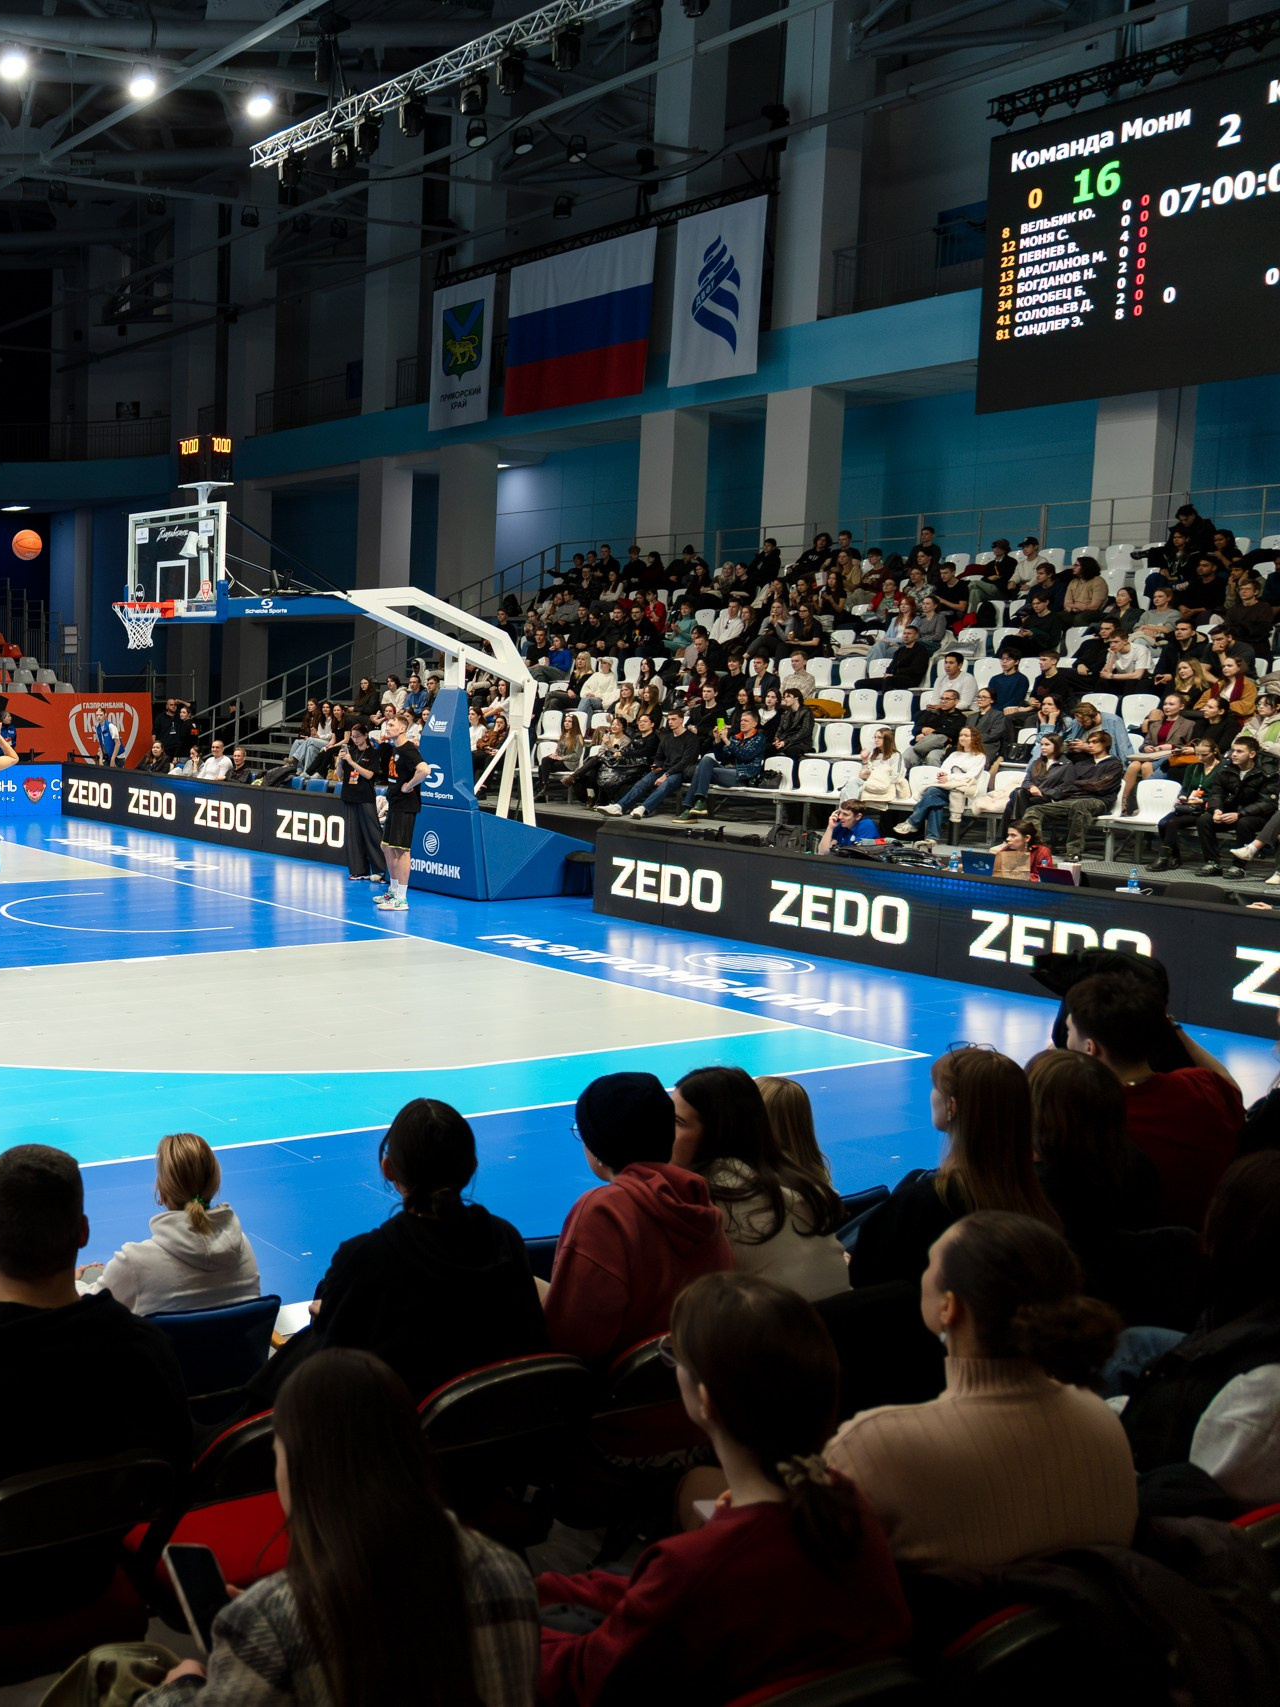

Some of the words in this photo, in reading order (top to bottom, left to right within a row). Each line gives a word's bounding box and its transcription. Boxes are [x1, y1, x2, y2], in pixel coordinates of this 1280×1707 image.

[1010, 130, 1114, 172] Команда
[1121, 109, 1191, 143] Мони
[1216, 113, 1242, 147] 2
[1028, 188, 1043, 209] 0
[1072, 160, 1121, 204] 16
[1002, 227, 1010, 238] 8
[1020, 211, 1076, 234] ВЕЛЬБИК
[1078, 208, 1096, 221] Ю.
[1122, 199, 1132, 212] 0
[1140, 194, 1150, 206] 0
[1002, 240, 1016, 253] 12
[1020, 232, 1055, 249] МОНЯ
[1057, 228, 1069, 240] С.
[1121, 214, 1130, 226] 0
[1140, 210, 1149, 222] 0
[1000, 256, 1015, 268] 22
[1018, 244, 1065, 264] ПЕВНЕВ
[1068, 242, 1080, 254] В.
[1120, 230, 1130, 242] 4
[1138, 226, 1148, 238] 0
[1000, 270, 1014, 283] 13
[1017, 254, 1090, 280] АРАСЛАНОВ
[1092, 250, 1108, 264] М.
[1118, 246, 1128, 258] 0
[1138, 241, 1147, 254] 0
[998, 285, 1014, 298] 23
[1016, 270, 1081, 294] БОГДАНОВ
[1083, 268, 1096, 280] Н.
[1118, 262, 1128, 274] 2
[1136, 257, 1146, 270] 0
[998, 299, 1012, 312] 34
[1016, 288, 1072, 309] КОРОБЕЦ
[1074, 286, 1086, 297] Б.
[1116, 277, 1126, 290] 0
[1136, 273, 1144, 286] 0
[1162, 286, 1176, 304] 0
[1265, 268, 1280, 285] 0
[996, 314, 1012, 326] 41
[1014, 301, 1078, 323] СОЛОВЬЕВ
[1080, 298, 1094, 312] Д.
[1116, 292, 1125, 306] 2
[1134, 288, 1144, 302] 0
[996, 328, 1010, 341] 81
[1014, 318, 1070, 338] САНДЛЕР
[1071, 316, 1084, 328] Э.
[1114, 308, 1124, 320] 8
[1134, 304, 1143, 317] 0
[440, 385, 481, 402] ПРИМОРСКИЙ
[451, 399, 467, 410] КРАЙ
[84, 712, 125, 732] КУОК
[68, 778, 112, 810] ZEDO
[127, 787, 177, 821] ZEDO
[434, 792, 454, 800] Sports
[194, 797, 252, 834] ZEDO
[276, 809, 344, 848] ZEDO
[410, 858, 460, 880] ЗПРОМБАНК
[611, 856, 722, 914] ZEDO
[769, 880, 909, 944] ZEDO
[476, 934, 868, 1016] ГАЗПРОМБАНК
